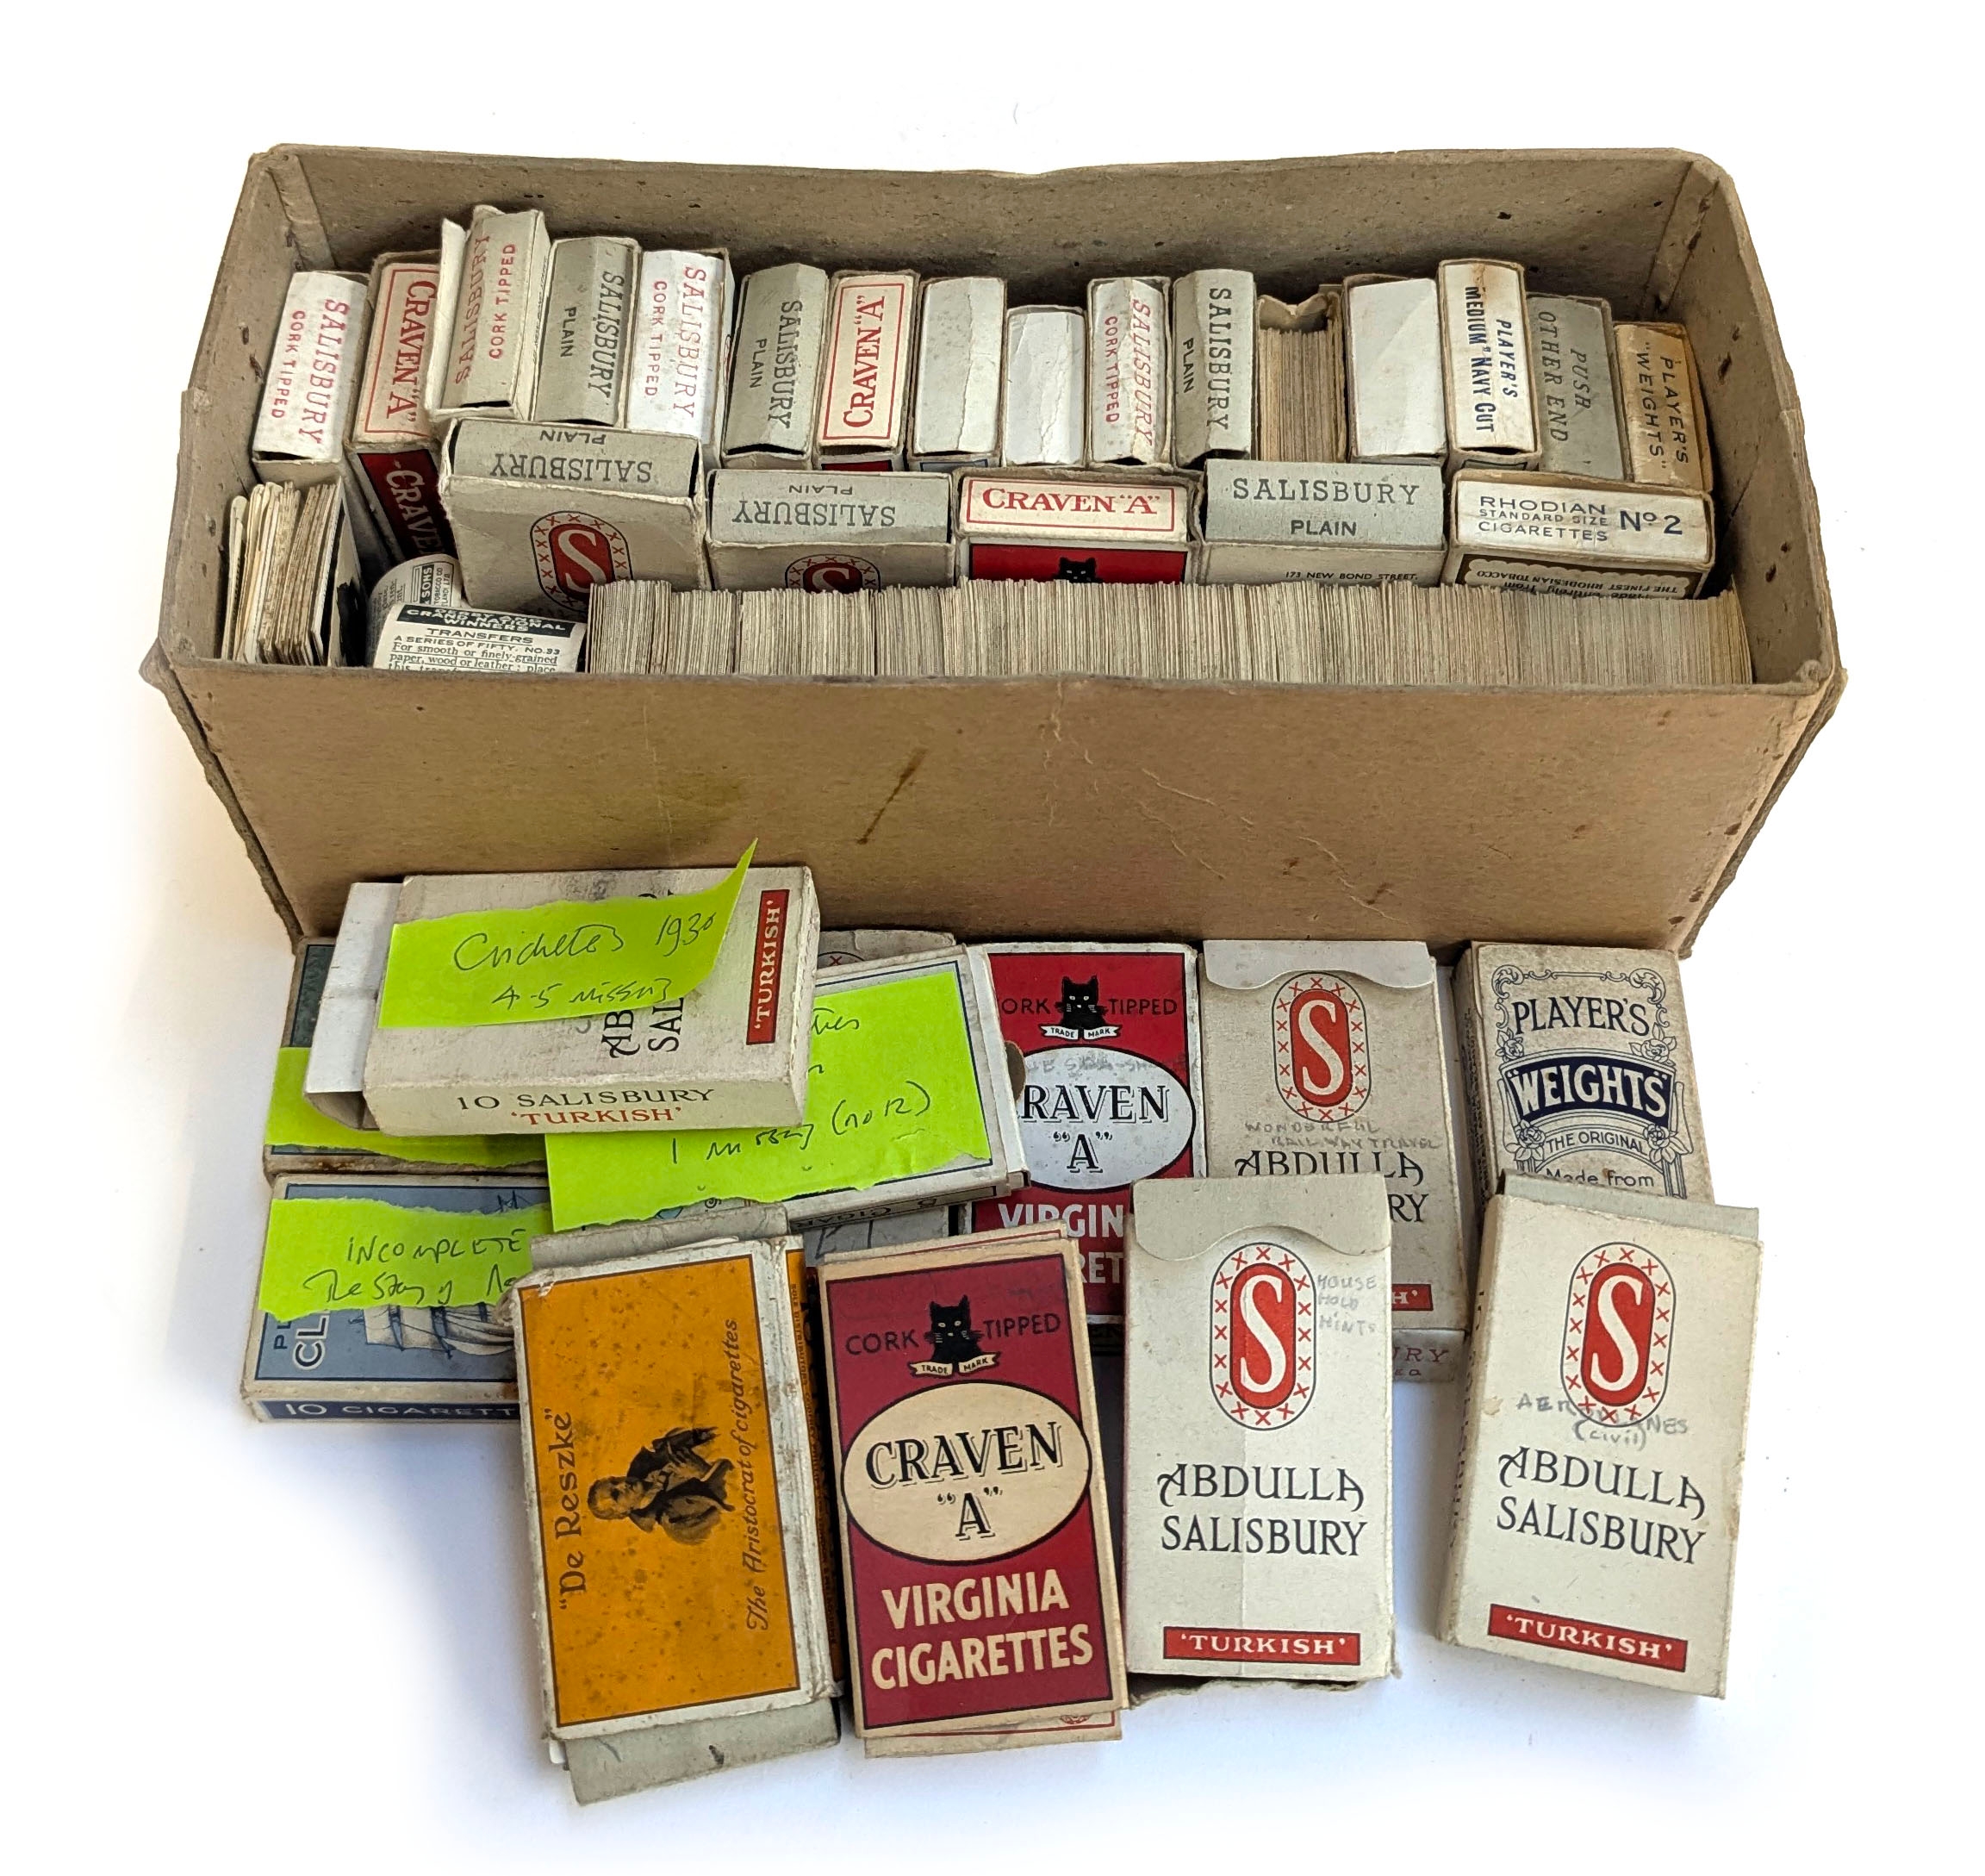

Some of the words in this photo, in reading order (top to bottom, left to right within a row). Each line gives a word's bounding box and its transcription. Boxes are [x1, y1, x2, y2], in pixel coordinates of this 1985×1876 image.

[495, 244, 516, 304] TIPPED
[455, 235, 490, 384] SALISBURY
[651, 280, 668, 326] CORK
[285, 310, 306, 352] CORK
[392, 280, 438, 386] CRAVEN
[488, 312, 508, 360] CORK
[560, 307, 577, 358] PLAIN
[588, 271, 625, 399] SALISBURY
[673, 266, 706, 418] SALISBURY
[1104, 316, 1118, 358] CORK
[1538, 311, 1563, 386] OTHER
[299, 299, 351, 445] SALISBURY
[644, 333, 663, 396] TIPPED
[750, 338, 768, 389] PLAIN
[768, 300, 803, 429] SALISBURY
[843, 327, 882, 427] CRAVEN
[1132, 298, 1154, 446] SALISBURY
[1183, 337, 1195, 394] PLAIN
[1206, 288, 1233, 430] SALISBURY
[1471, 357, 1493, 396] NAVY
[1496, 319, 1518, 399] PLAYER'S
[1570, 348, 1591, 409] PUSH
[271, 358, 296, 419] TIPPED
[1105, 362, 1120, 423] TIPPED
[1636, 341, 1667, 470] "WEIGHTS"
[1474, 402, 1497, 433] CUT
[1547, 395, 1569, 442] END
[1660, 356, 1689, 464] PLAYER'S
[540, 429, 607, 445] PLAIN
[489, 452, 653, 483] SALISBURY
[788, 485, 853, 495] PLAIN
[982, 488, 1115, 513] CRAVEN
[1233, 478, 1420, 505] SALISBURY
[1479, 495, 1606, 515] RHODIAN
[732, 500, 896, 527] SALISBURY
[1291, 520, 1357, 536] PLAIN
[1478, 508, 1564, 522] STANDARD
[1572, 515, 1609, 527] SIZE
[1478, 520, 1609, 542] CIGARETTES
[1664, 515, 1683, 535] 2
[1477, 570, 1530, 583] TOBACCO
[1533, 577, 1604, 589] RHODESIAN
[1609, 583, 1651, 592] FINEST
[1653, 585, 1678, 594] THE
[406, 636, 454, 646] SERIES
[477, 642, 519, 651] FIFTY.
[426, 627, 533, 644] TRANSFERS
[445, 618, 529, 632] WINNERS
[389, 653, 426, 665] paper,
[428, 656, 457, 666] wood
[459, 659, 473, 668] or
[474, 658, 514, 670] leather
[527, 663, 556, 672] place
[392, 641, 414, 651] For
[417, 645, 458, 656] smooth
[481, 651, 558, 664] finely-grained
[753, 899, 781, 1031] 'TURKISH'
[1001, 998, 1051, 1015] ORK
[1108, 998, 1178, 1015] TIPPED
[1511, 995, 1650, 1037] PLAYER'S
[1050, 1026, 1075, 1038] TRADE
[1087, 1027, 1111, 1038] MARK
[1297, 999, 1344, 1096] S
[457, 1095, 500, 1110] 10
[517, 1088, 715, 1108] SALISBURY
[511, 1106, 683, 1126] 'TURKISH'
[1021, 1084, 1170, 1124] RAVEN
[1053, 1131, 1113, 1174] "A"
[1546, 1134, 1574, 1154] THE
[1577, 1131, 1651, 1156] ORIGINAL
[1235, 1150, 1424, 1187] ABDULLA
[1607, 1170, 1655, 1188] from
[998, 1203, 1124, 1238] VIRGIN
[347, 1228, 526, 1264] INCOMPLETE
[1317, 1274, 1377, 1291] HOUSE
[1318, 1293, 1359, 1309] HOLD
[845, 1329, 920, 1356] CORK
[983, 1312, 1061, 1341] TIPPED
[1239, 1274, 1287, 1393] S
[1590, 1274, 1644, 1393] S
[722, 1319, 753, 1433] cigarettes
[921, 1363, 949, 1374] TRADE
[963, 1356, 988, 1372] MARK
[285, 1404, 327, 1416] 10
[342, 1405, 517, 1417] CIGARETT
[1516, 1393, 1689, 1435] AERONES
[731, 1427, 757, 1457] of
[865, 1421, 1064, 1490] CRAVEN
[544, 1407, 583, 1540] Reszke"
[1157, 1463, 1365, 1512] ABDULLA
[1497, 1445, 1706, 1521] ABDULLA
[736, 1458, 767, 1574] Aristocrat
[936, 1486, 1004, 1541] "A"
[1497, 1496, 1707, 1564] SALISBURY
[1161, 1514, 1368, 1556] SALISBURY
[558, 1550, 588, 1611] "De
[881, 1568, 1070, 1630] VIRGINIA
[746, 1585, 769, 1631] The
[871, 1624, 1094, 1690] CIGARETTES
[1180, 1633, 1347, 1655] 'TURKISH'
[1506, 1614, 1672, 1661] 'TURKISH'
